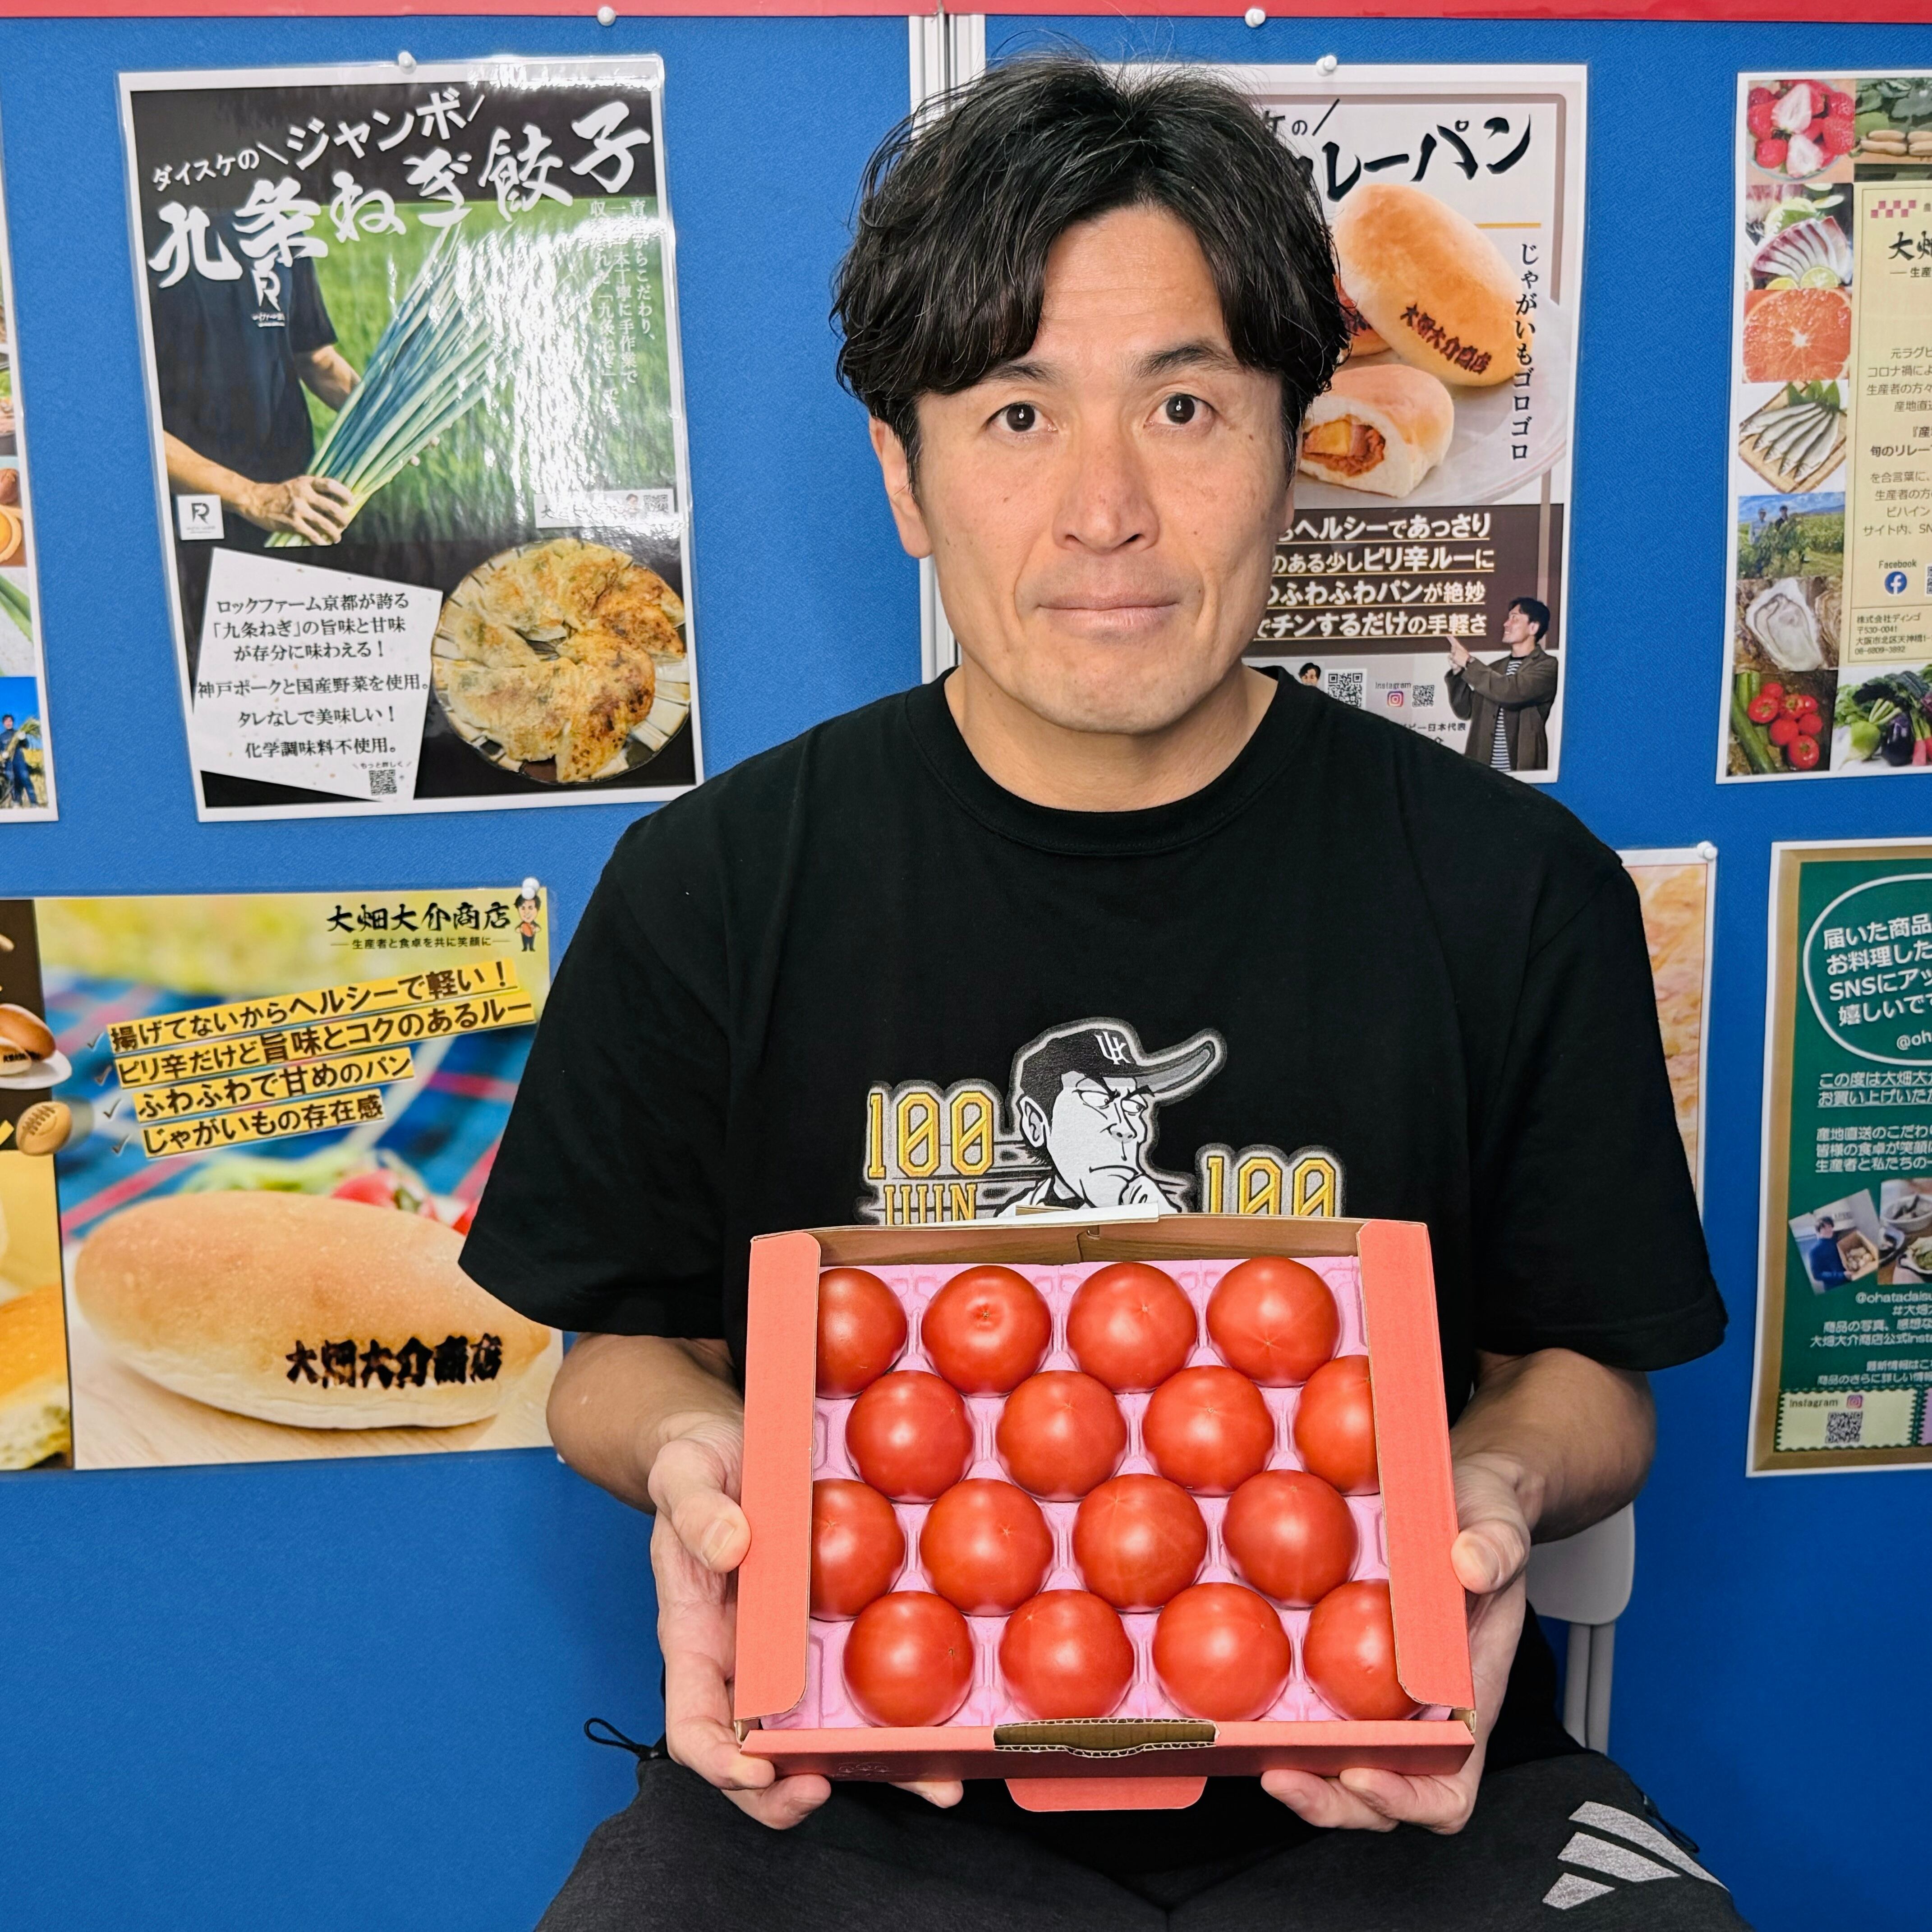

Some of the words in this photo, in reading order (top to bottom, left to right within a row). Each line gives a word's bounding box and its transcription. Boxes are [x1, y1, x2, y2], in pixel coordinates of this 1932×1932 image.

[152, 149, 260, 192] ダイスケの
[286, 88, 467, 170] ジャンボ
[1301, 114, 1531, 202] レーパン
[148, 101, 651, 288] 九条ねぎ餃子
[1512, 244, 1539, 460] じゃがいもゴロゴロ
[1894, 400, 1932, 413] 産地直
[1913, 426, 1932, 438] 『産
[1870, 444, 1932, 457] 旬のリレー
[1875, 489, 1932, 501] 生産者の方
[1878, 559, 1918, 570] Facebook
[216, 592, 409, 616] ロックファーム京都が誇る
[214, 618, 406, 639] 「九条ねぎ」の旨味と甘味
[234, 642, 384, 662] が存分に味わえる！
[198, 674, 430, 699] 神戸ポークと国産野菜を使用。
[1375, 681, 1412, 690] Instagram
[238, 706, 396, 727] タレなしで美味しい！
[244, 737, 397, 759] 化学調味料不使用。
[327, 902, 511, 933] 大畑大介商店
[352, 937, 492, 950] 生産者と食卓を共に笑顔に
[110, 960, 508, 1053] 揚げてないからヘルシーで軽い！
[118, 999, 532, 1084] ピリ辛だけど旨味とコクのあるルー
[138, 1055, 412, 1118] ふわふわで甘めのパン
[1819, 1071, 1932, 1087] この度は大畑大
[1818, 1088, 1932, 1105] お買い上げいた
[143, 1094, 383, 1155] じゃがいもの存在感
[868, 1090, 994, 1179] 100
[1789, 1398, 1839, 1409] Instagram
